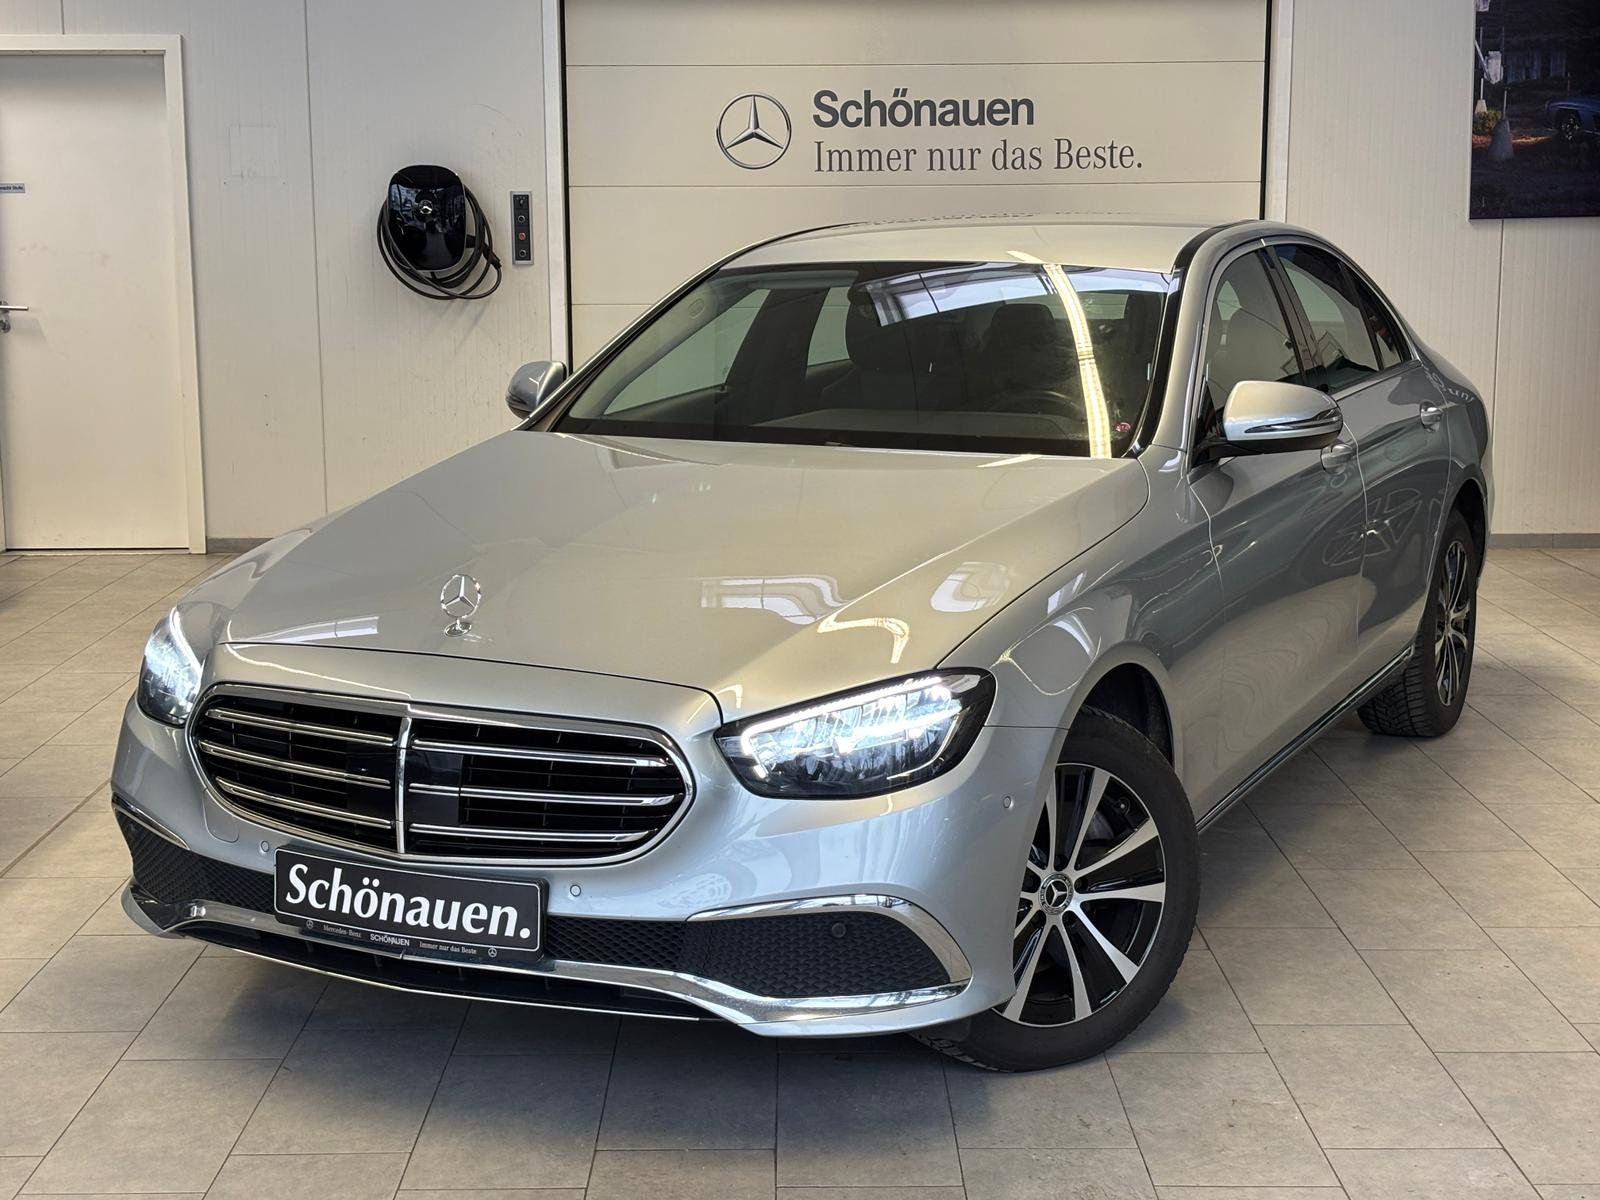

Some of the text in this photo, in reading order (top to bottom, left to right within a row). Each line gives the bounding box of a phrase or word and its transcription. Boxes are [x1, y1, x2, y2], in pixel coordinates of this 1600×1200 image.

[813, 88, 1035, 128] Schönauen
[813, 137, 1143, 173] Immer nur das Beste.
[285, 863, 532, 940] Schönauen.
[370, 933, 410, 946] SCHÖNAUEN
[419, 941, 438, 950] Immer
[450, 945, 460, 953] das
[461, 946, 477, 955] Beste
